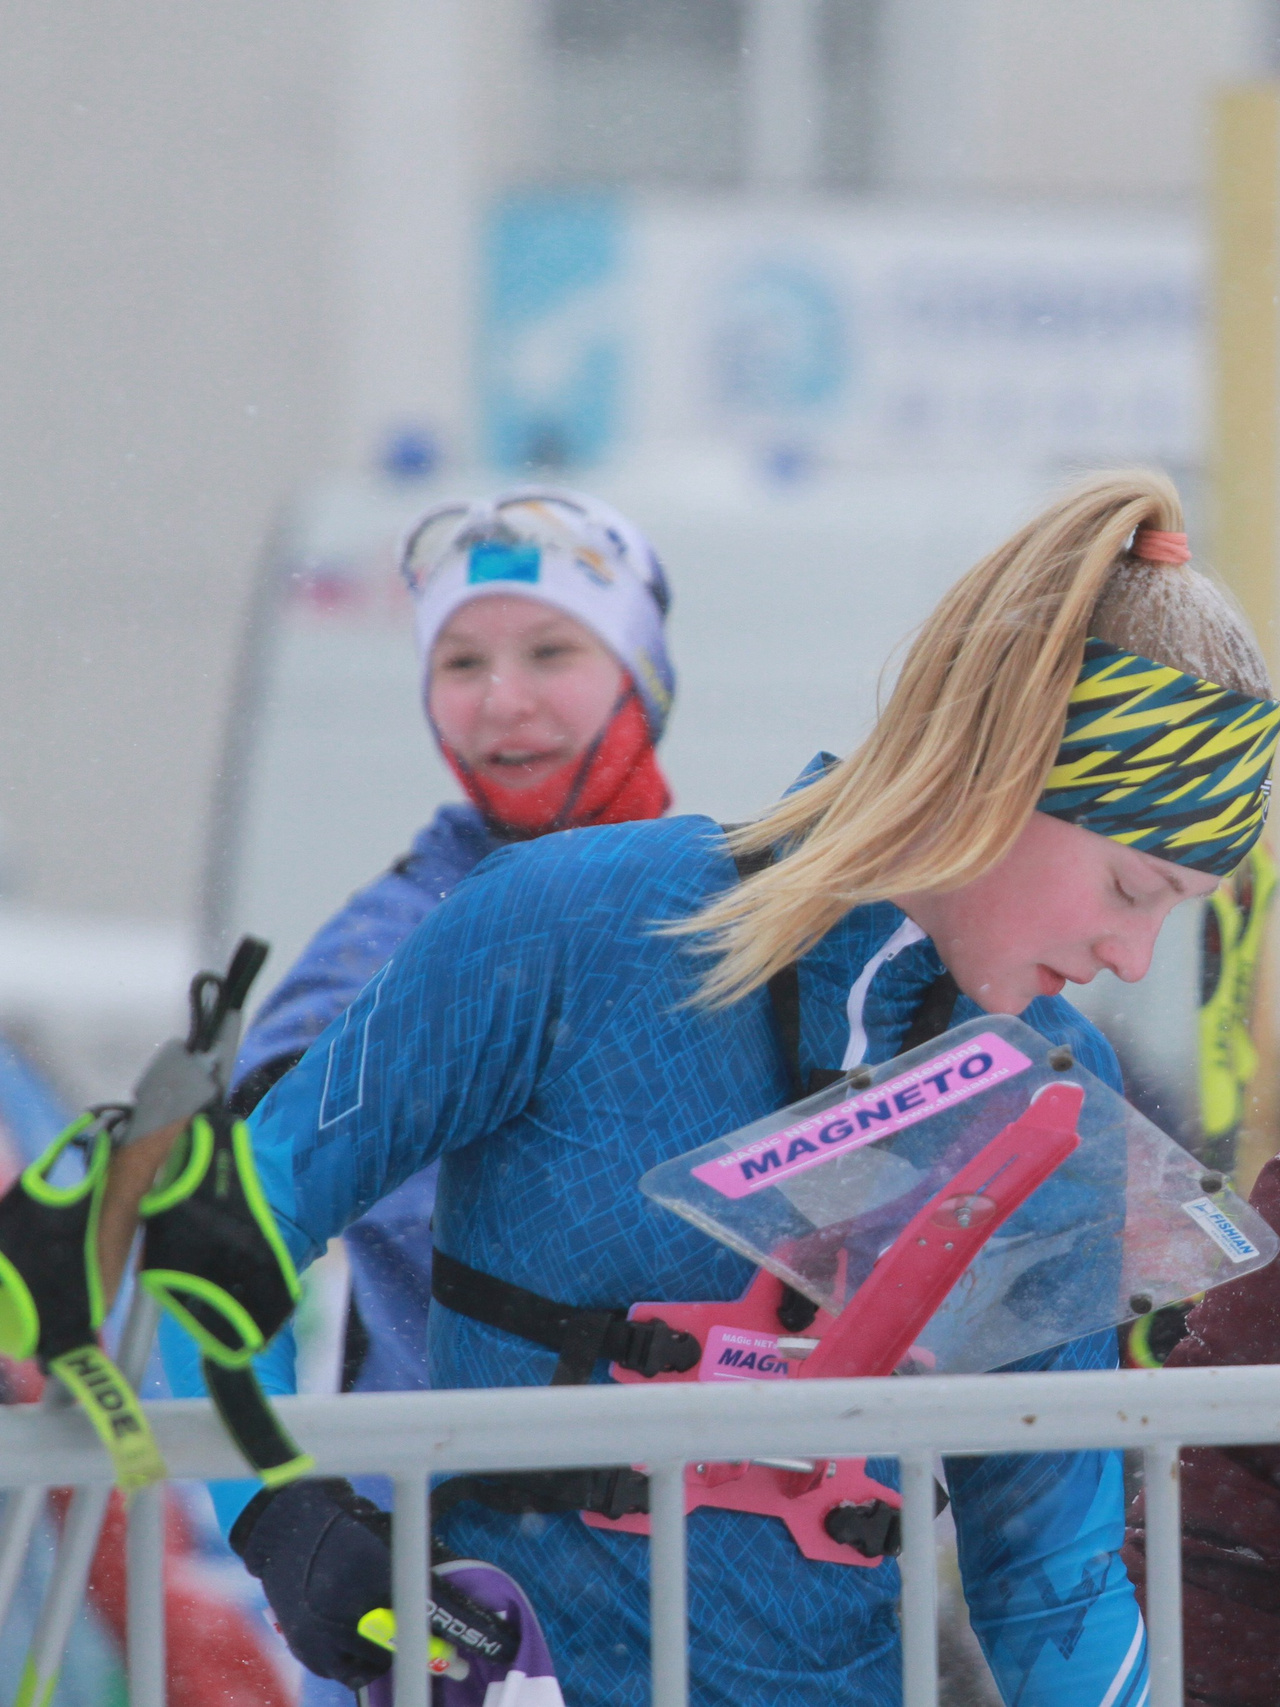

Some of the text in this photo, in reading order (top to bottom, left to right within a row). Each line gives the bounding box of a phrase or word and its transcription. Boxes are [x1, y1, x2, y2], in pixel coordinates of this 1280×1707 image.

[718, 1043, 983, 1167] MAGic NETs of Orienteering
[739, 1052, 993, 1180] MAGNETO
[895, 1067, 1010, 1125] www.fishian.ru
[1209, 1213, 1255, 1254] FISHIAN
[722, 1333, 752, 1345] MAGic
